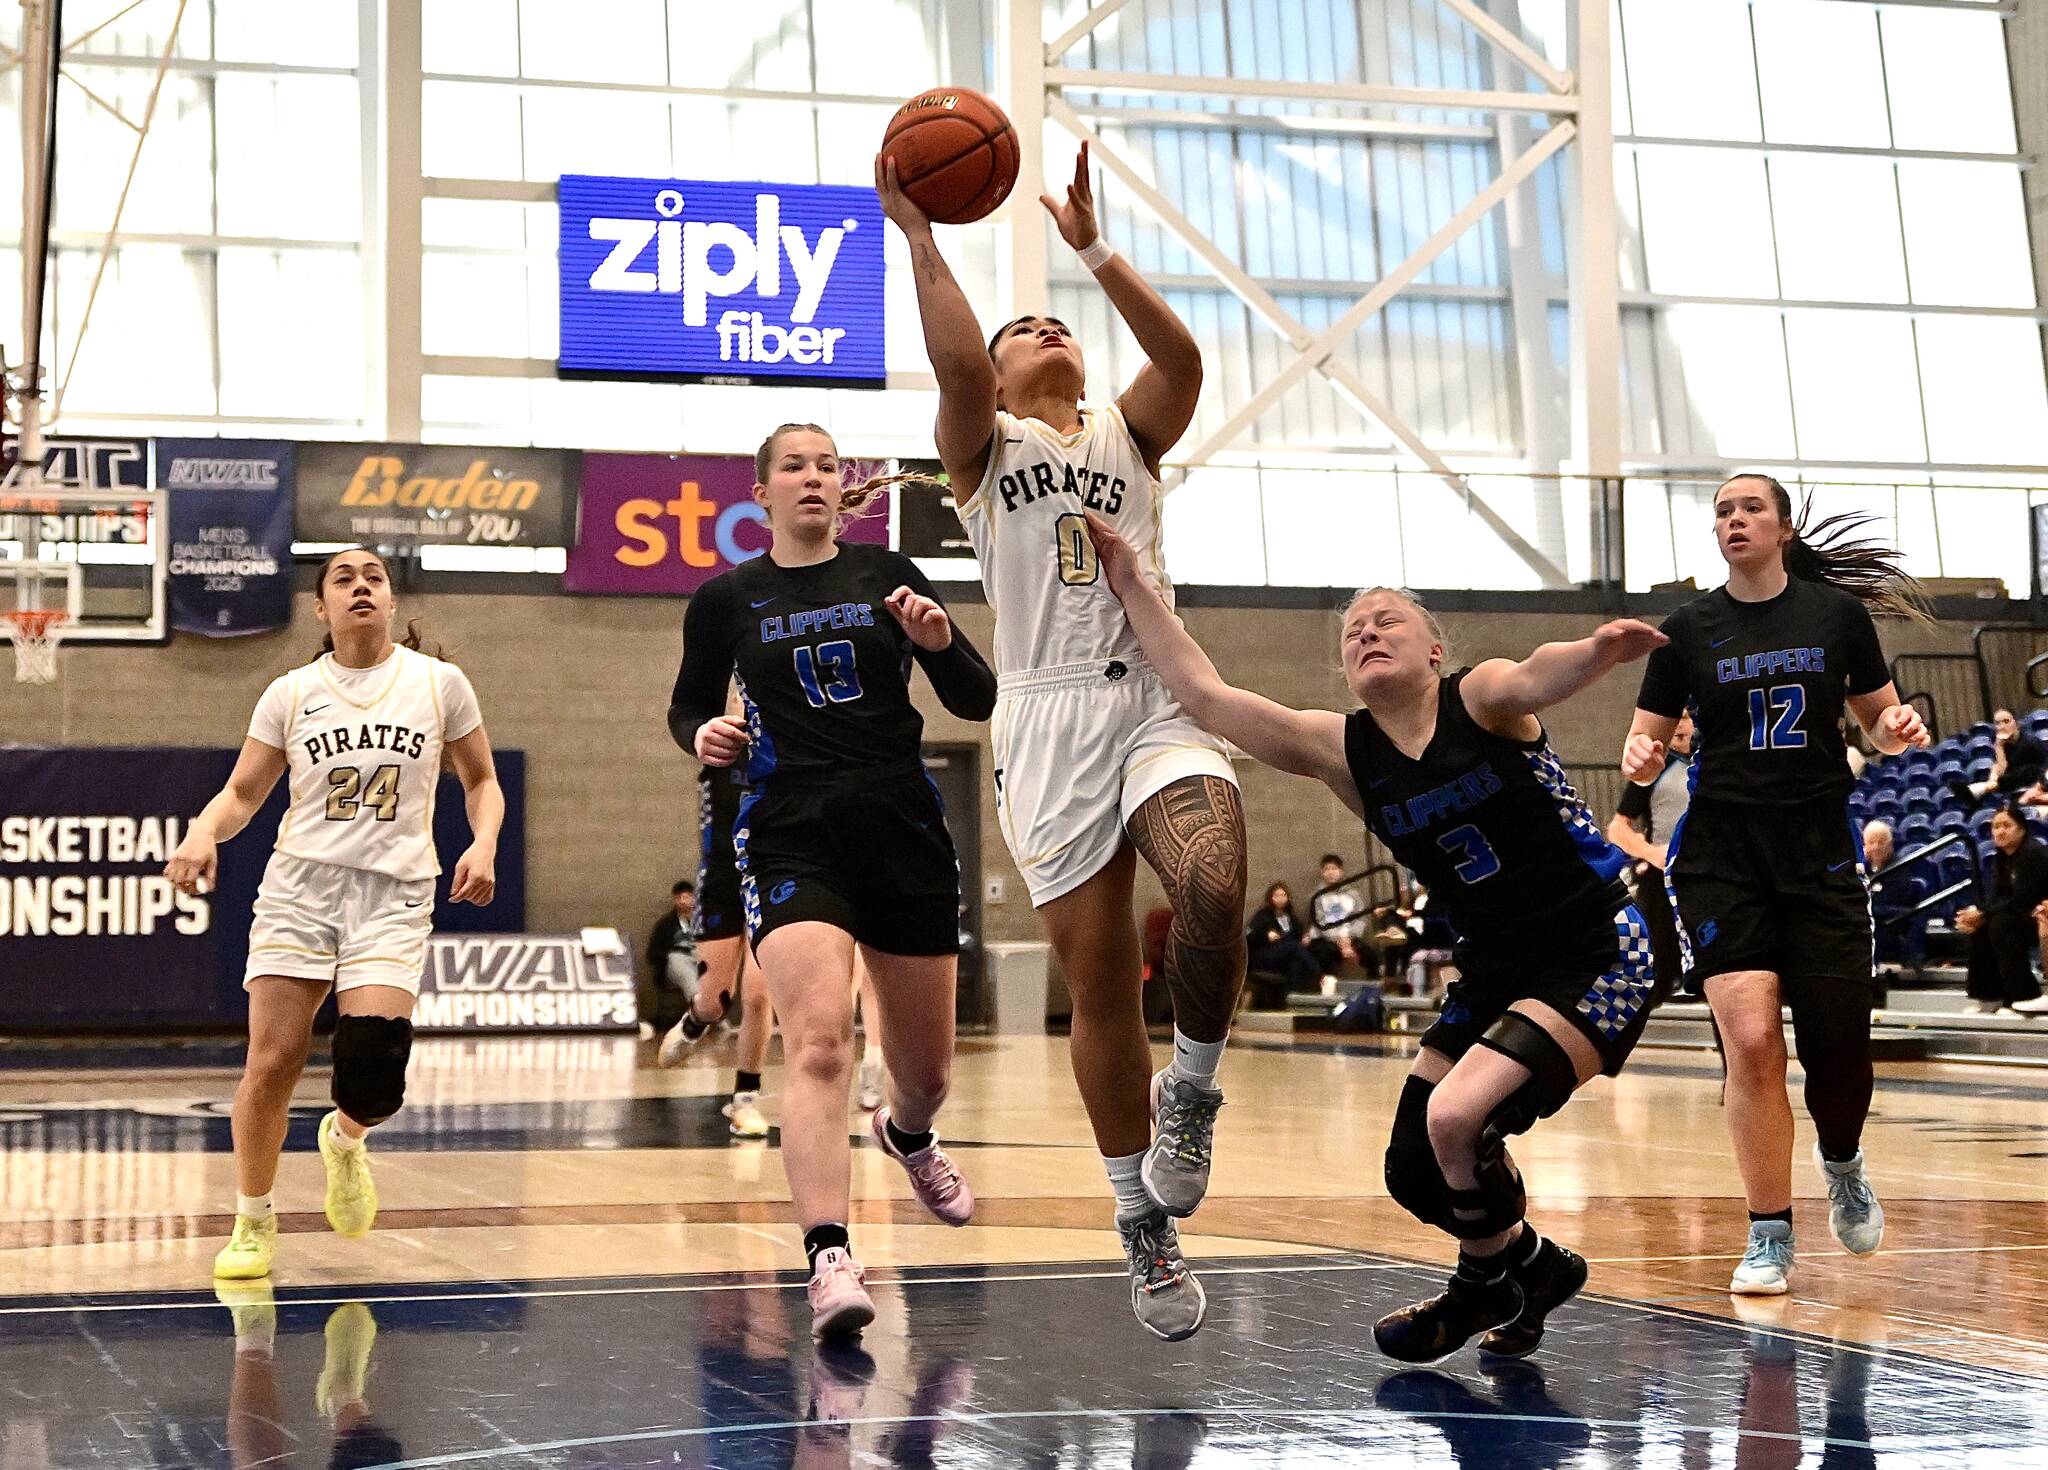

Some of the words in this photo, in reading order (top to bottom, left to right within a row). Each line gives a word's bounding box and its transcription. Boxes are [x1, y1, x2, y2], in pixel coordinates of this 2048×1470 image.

[588, 189, 847, 327] ziply
[715, 311, 846, 364] fiber
[169, 459, 279, 488] NWAC
[340, 456, 542, 511] Baden
[999, 462, 1127, 515] PIRATES
[169, 559, 279, 576] CHAMPIONS
[173, 543, 274, 561] BASKETBALL
[1055, 512, 1100, 587] 0
[760, 603, 875, 643] CLIPPERS
[793, 640, 864, 708] 13
[1717, 648, 1825, 684] CLIPPERS
[1747, 684, 1808, 750] 12
[304, 724, 426, 765] PIRATES
[325, 764, 401, 821] 24
[1380, 761, 1503, 836] CLIPPERS
[0, 815, 198, 863] SKETBAL
[1436, 823, 1501, 885] 3
[421, 938, 634, 992] WAC
